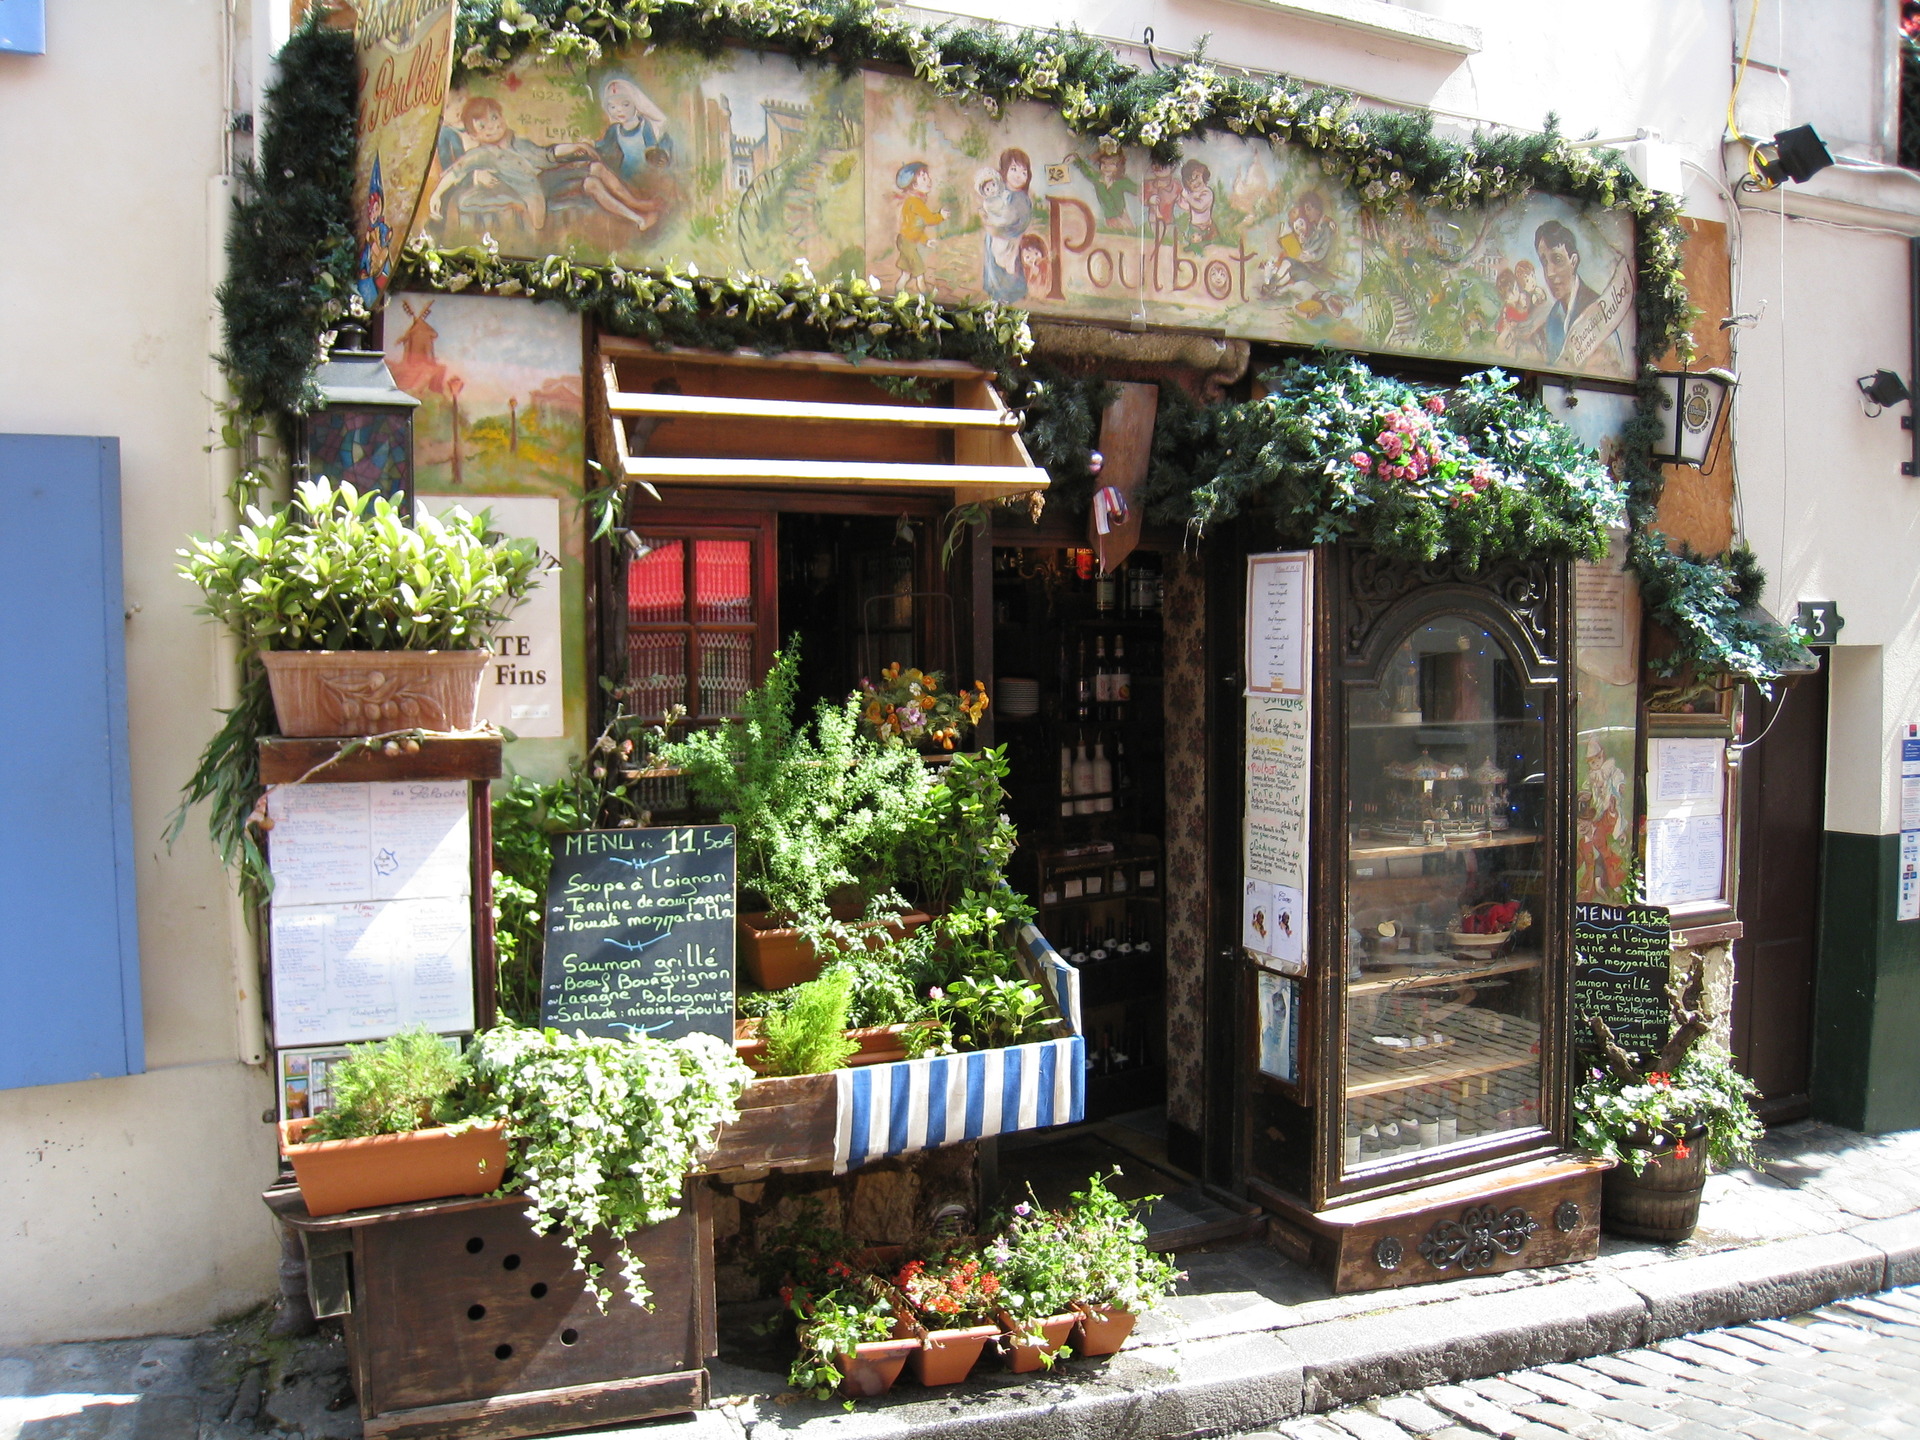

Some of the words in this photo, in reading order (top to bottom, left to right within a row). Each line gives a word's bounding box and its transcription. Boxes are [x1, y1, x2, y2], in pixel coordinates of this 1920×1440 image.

[1044, 195, 1258, 303] Poulbot
[1812, 608, 1825, 637] 3
[495, 663, 547, 685] Fins
[565, 834, 635, 855] MENU
[564, 873, 626, 899] Soupe
[637, 895, 653, 909] de
[656, 892, 735, 913] campagne
[1575, 905, 1622, 921] MENU
[1575, 928, 1607, 944] Soupe
[562, 953, 641, 974] Saumon
[653, 943, 719, 976] grillé
[1610, 943, 1622, 953] de
[1625, 948, 1670, 961] campagne
[1575, 979, 1609, 988] aumon
[1614, 976, 1651, 994] grillé
[558, 990, 631, 1007] Lasagne
[642, 987, 734, 1009] Bolognaise
[1595, 990, 1659, 1007] Bourguignon
[684, 1002, 734, 1021] poulet
[1574, 1003, 1611, 1014] asagne
[1641, 1018, 1667, 1029] poulet
